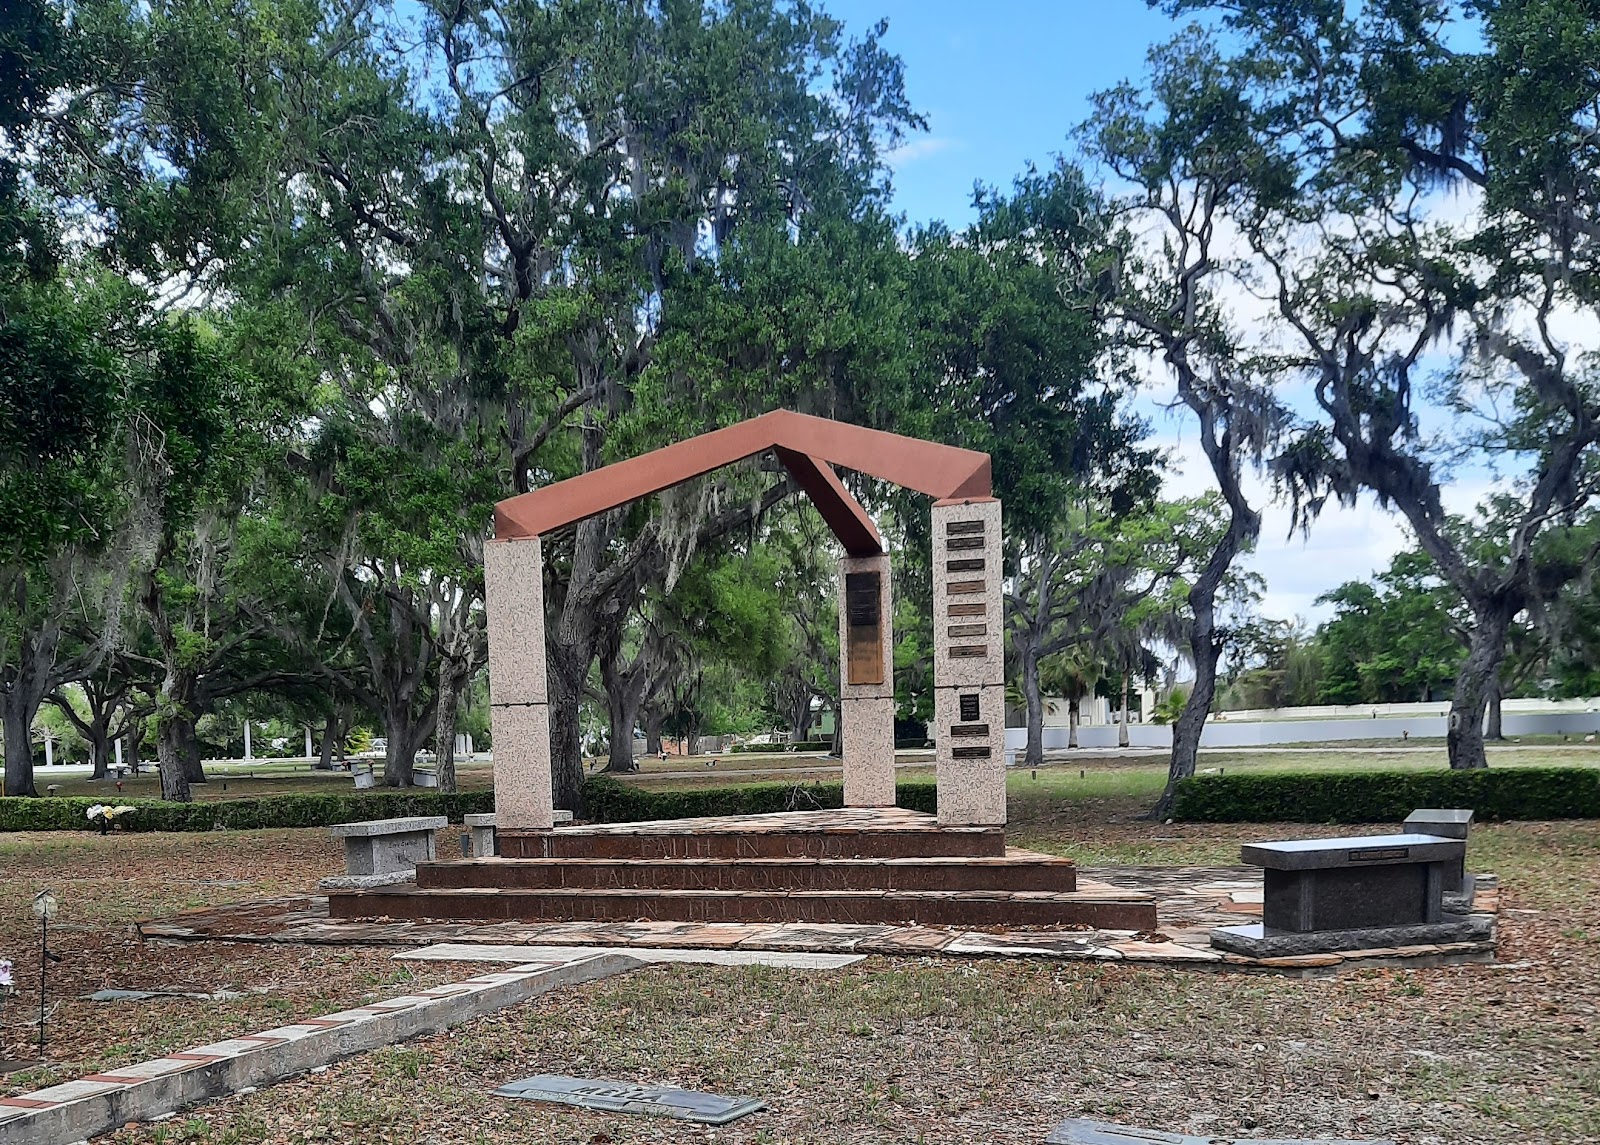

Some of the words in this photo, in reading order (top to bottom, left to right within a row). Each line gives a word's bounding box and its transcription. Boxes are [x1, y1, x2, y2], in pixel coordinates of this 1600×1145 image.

[640, 837, 711, 857] FAITH
[736, 837, 760, 857] IN
[786, 837, 842, 858] GOD
[592, 867, 656, 887] FAITH
[683, 868, 705, 888] IN
[731, 867, 852, 889] COUNTRY
[539, 898, 605, 918] FAITH
[635, 899, 659, 919] IN
[571, 1087, 662, 1102] MELLA
